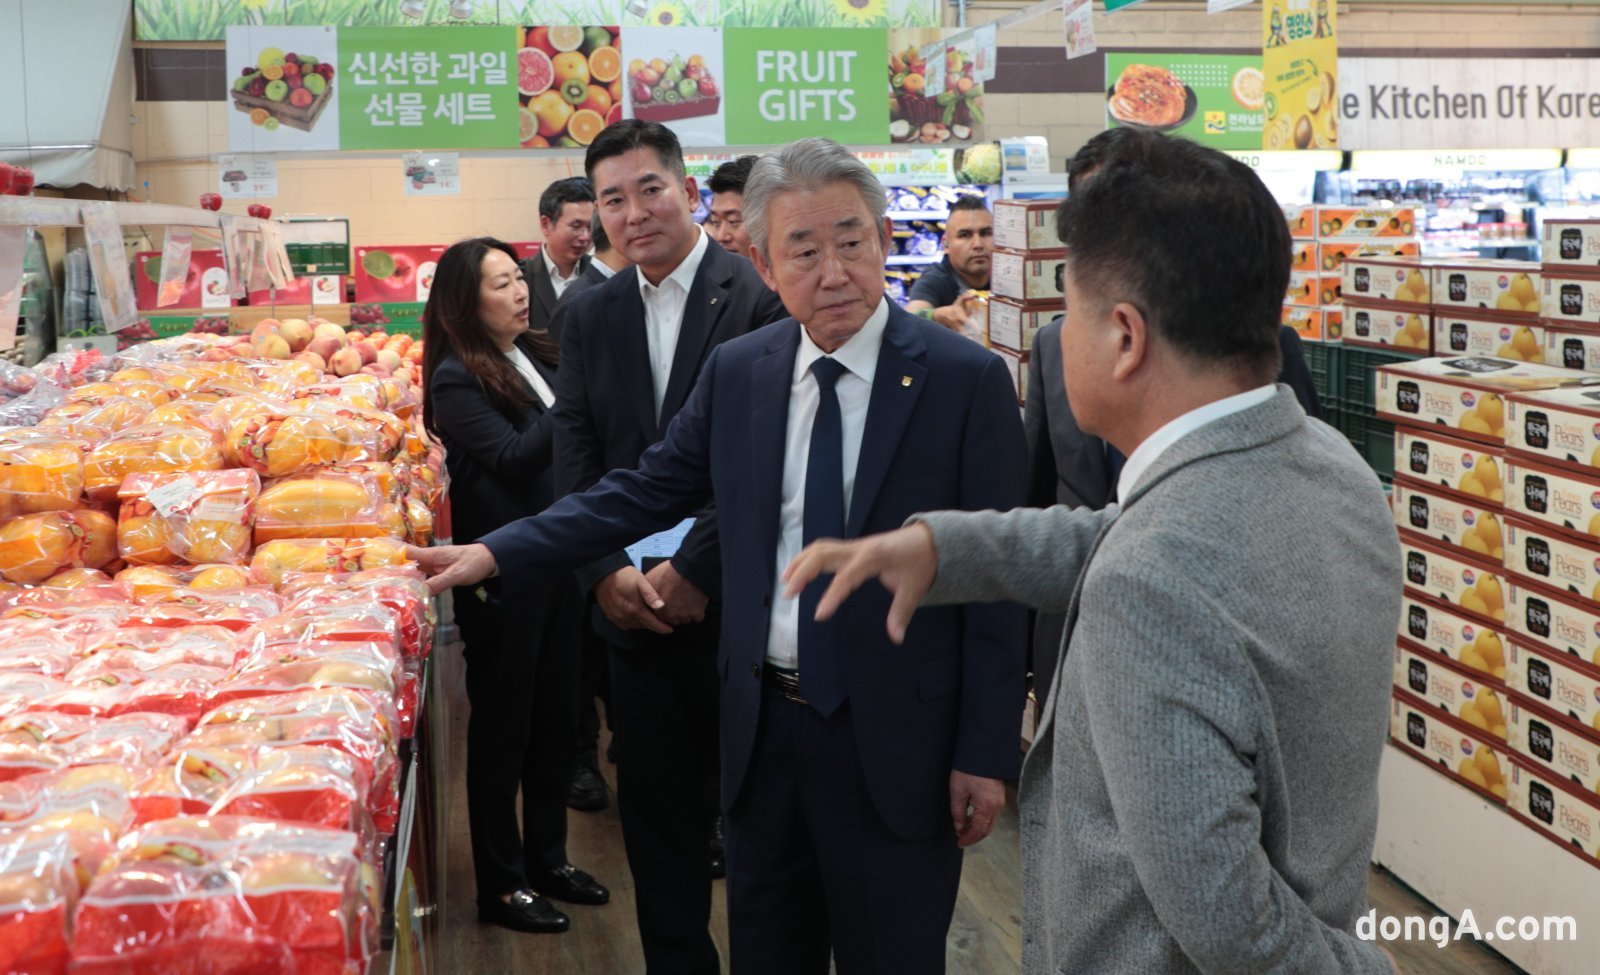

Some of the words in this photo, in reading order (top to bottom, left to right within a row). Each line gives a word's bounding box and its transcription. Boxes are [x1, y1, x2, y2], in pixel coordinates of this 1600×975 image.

[348, 51, 442, 85] 신선한
[447, 51, 508, 85] 과일
[756, 50, 857, 82] FRUIT
[364, 92, 427, 126] 선물
[433, 92, 496, 126] 세트
[758, 89, 857, 121] GIFTS
[1369, 85, 1487, 119] Kitchen
[1497, 85, 1528, 119] Of
[1434, 155, 1486, 165] NAMDO
[1425, 392, 1453, 413] Pears
[1555, 424, 1584, 447] Pears
[1553, 490, 1582, 514] Pears
[1556, 553, 1586, 580] Pears
[1556, 615, 1586, 643] Pears
[1557, 678, 1586, 707] Pears
[1559, 741, 1589, 773] Pears
[1560, 804, 1590, 837] Pears
